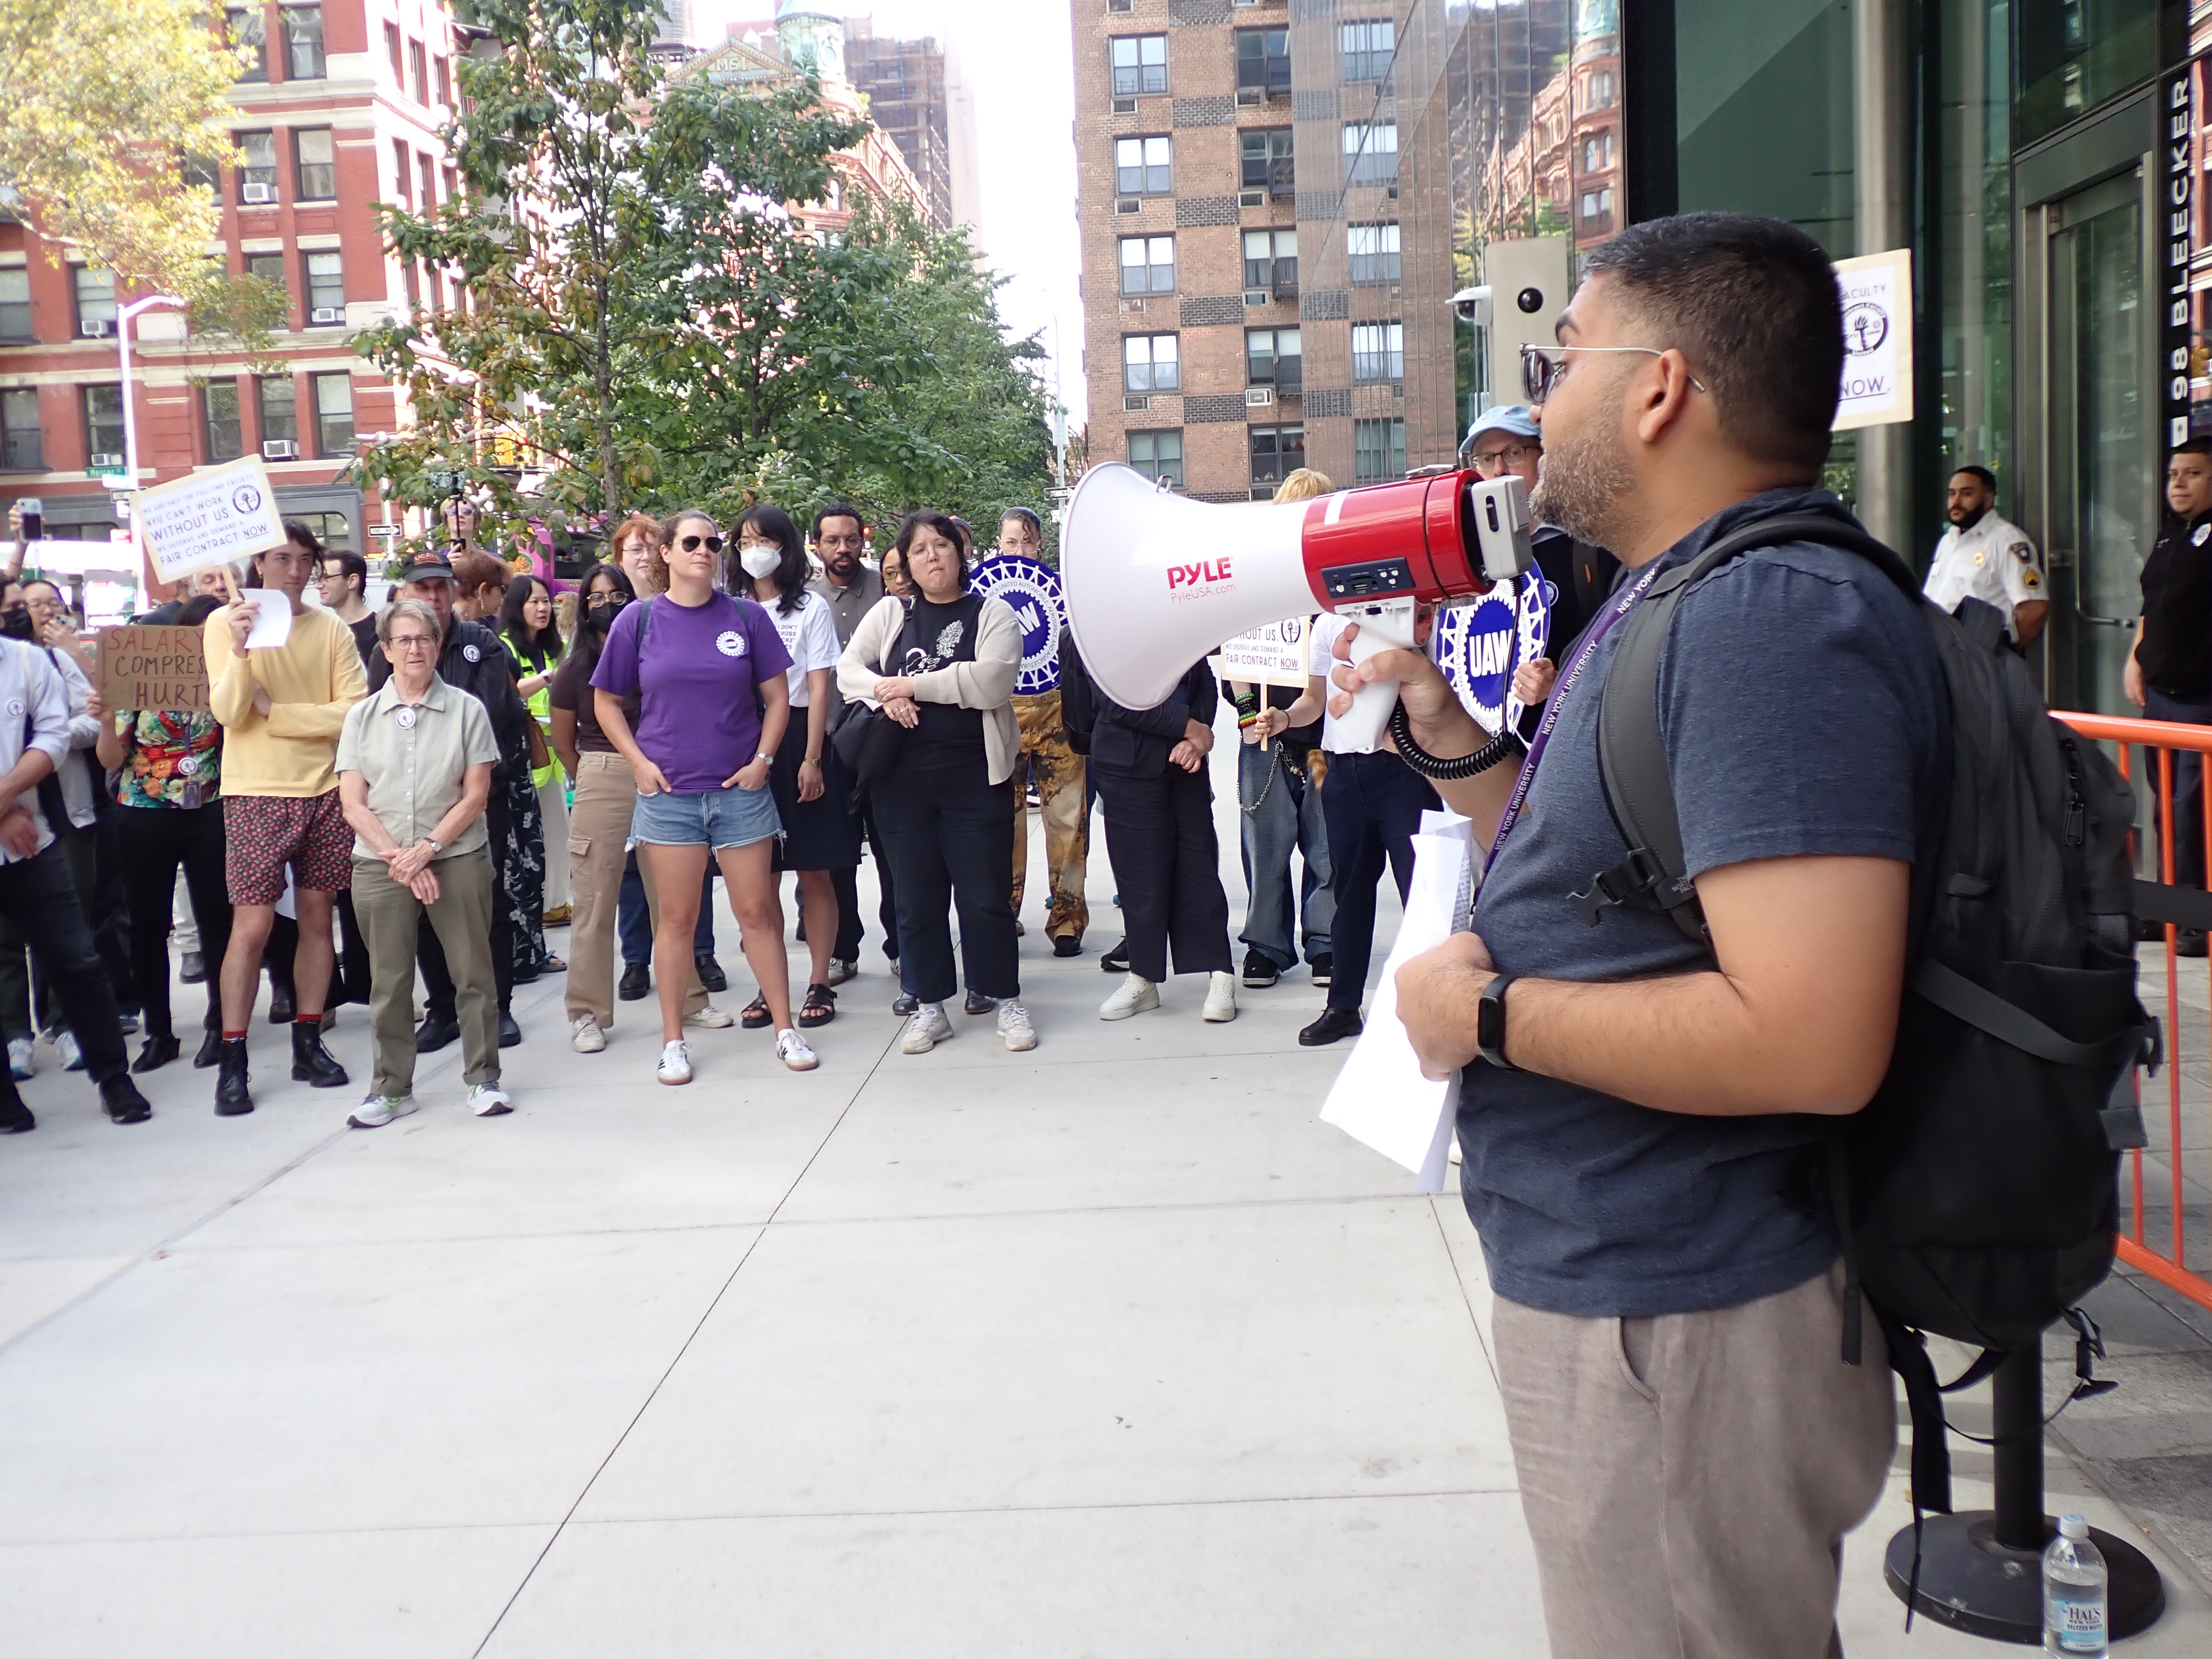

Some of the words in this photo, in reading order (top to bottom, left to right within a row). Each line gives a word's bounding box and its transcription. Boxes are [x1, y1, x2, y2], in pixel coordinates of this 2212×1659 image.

[716, 56, 747, 71] MSI
[2171, 77, 2188, 327] BLEECKER
[1840, 283, 1890, 299] ACULTY.
[2171, 346, 2188, 400] 98
[90, 468, 114, 477] Mercer
[145, 515, 163, 527] NYU
[166, 505, 191, 520] CAN'T
[195, 495, 223, 510] WORK
[166, 497, 180, 506] HALF
[149, 513, 207, 541] WITHOUT
[213, 508, 233, 521] US.
[156, 545, 166, 553] WE
[168, 536, 195, 549] DESERVE
[211, 522, 237, 535] DEMAND
[159, 551, 182, 565] FAIR
[185, 532, 238, 556] CONTRACT
[1167, 556, 1232, 589] PYLE
[988, 587, 999, 598] RICA
[999, 581, 1018, 590] UNITED
[1171, 584, 1236, 604] PyleUSA.com
[1616, 591, 1636, 614] NEW
[1047, 606, 1058, 639] AEROSPACE
[1048, 639, 1057, 651] AND
[1265, 629, 1279, 641] US.
[1020, 650, 1051, 669] AGRICULTURA
[1226, 654, 1239, 664] FAIR
[1241, 655, 1277, 667] CONTRACT
[1469, 629, 1514, 677] UAW
[115, 655, 208, 677] COMPRES
[1542, 713, 1557, 735] NEW
[1552, 689, 1568, 713] YORK
[1564, 640, 1598, 690] UNIVERSITY
[1494, 832, 1507, 851] NEW
[1502, 810, 1517, 831] YORK
[1511, 763, 1536, 809] UNIVERSITY
[2069, 1607, 2101, 1620] HAL'S
